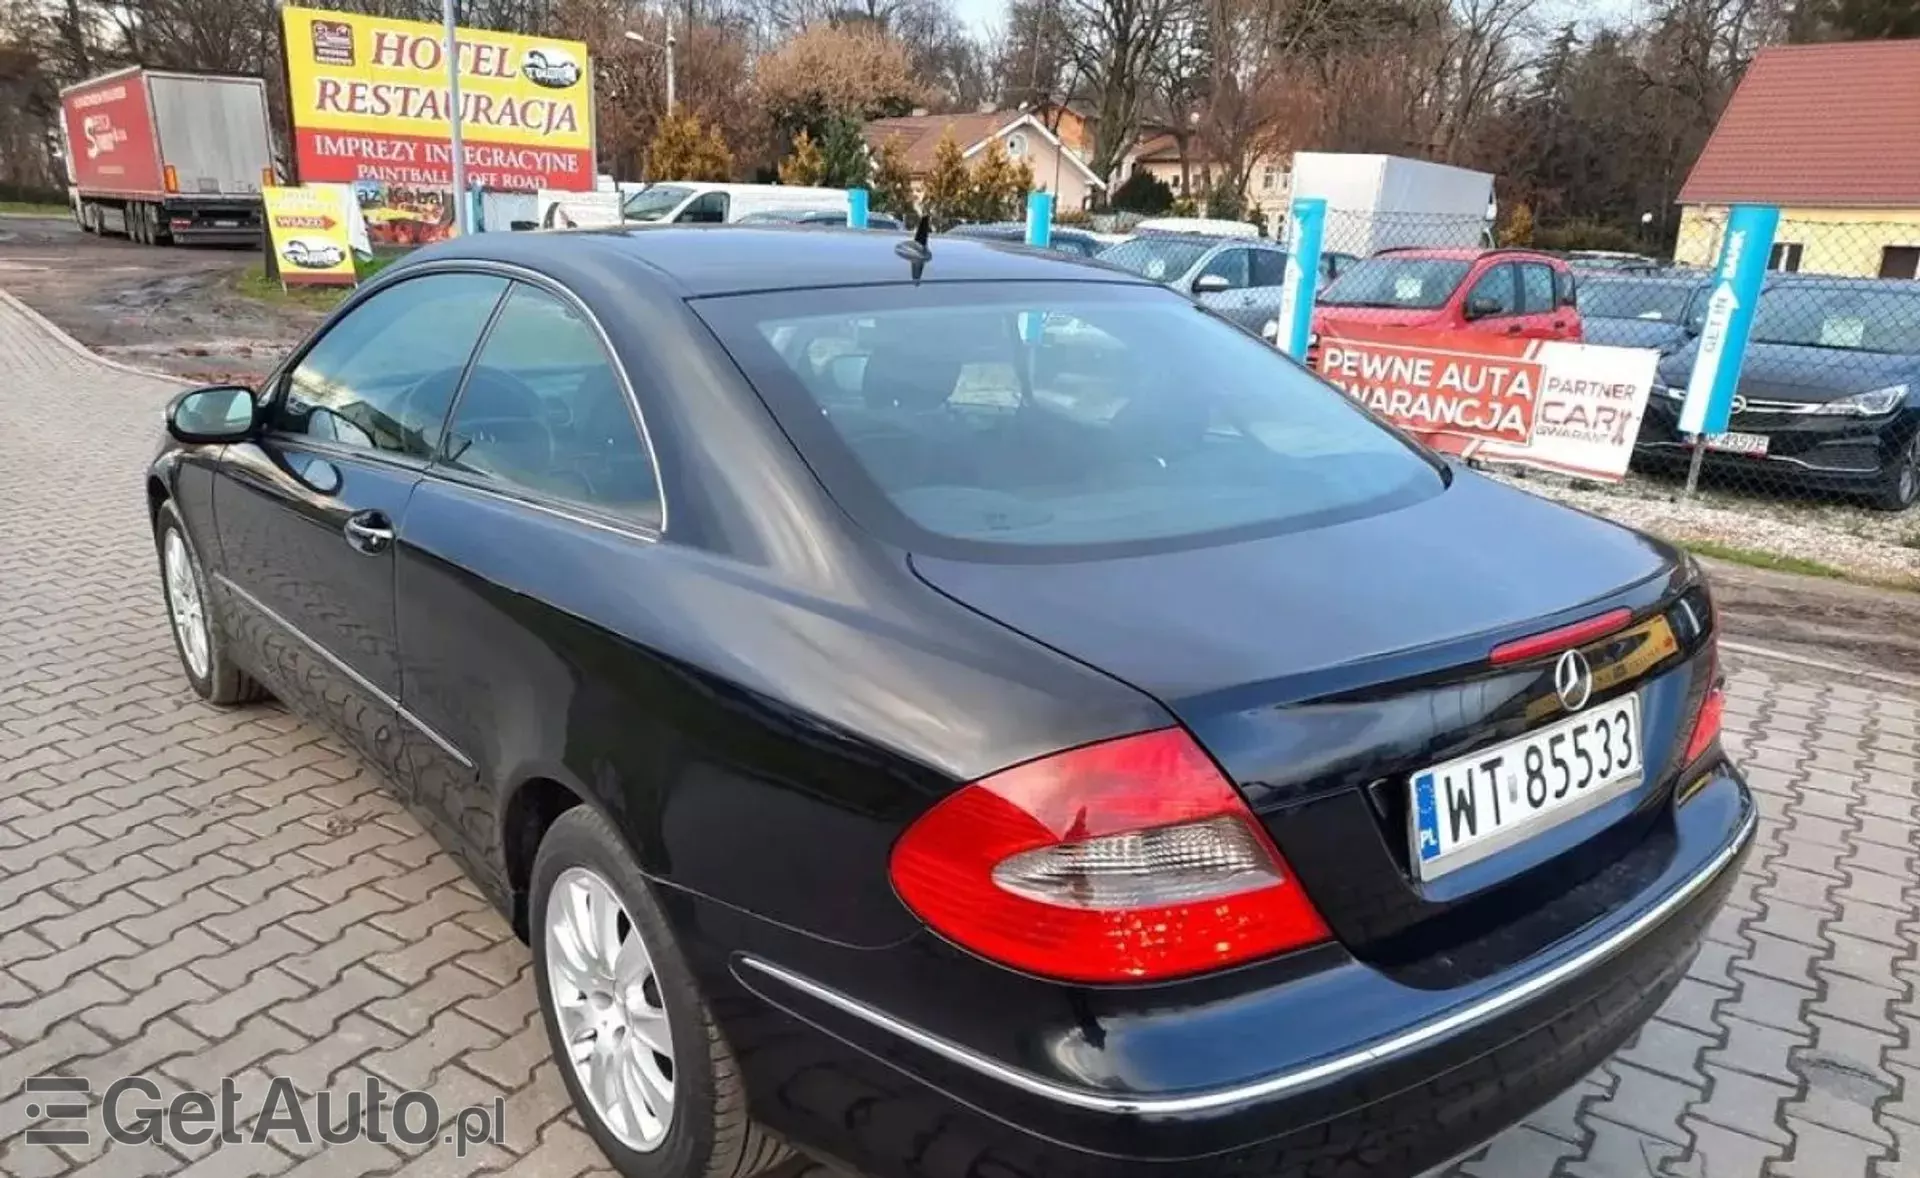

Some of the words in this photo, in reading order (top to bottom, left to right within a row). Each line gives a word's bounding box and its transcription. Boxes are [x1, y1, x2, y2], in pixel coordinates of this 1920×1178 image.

[371, 31, 518, 79] HOTEL
[316, 80, 578, 135] RESTAURACJA
[315, 134, 417, 162] IMPREZY
[425, 146, 579, 173] INEGRACYJNE
[357, 164, 452, 184] PAINTBALL
[467, 171, 498, 187] OFF
[501, 173, 548, 190] ROAD
[1323, 347, 1434, 389] PEWNE
[1437, 363, 1534, 400] AUTA
[1547, 376, 1636, 399] PARTNER
[1331, 379, 1526, 435] WARANCJA
[1541, 401, 1617, 431] CAR
[1445, 758, 1503, 844] WT
[1524, 710, 1633, 809] 85533
[1420, 828, 1437, 849] PL
